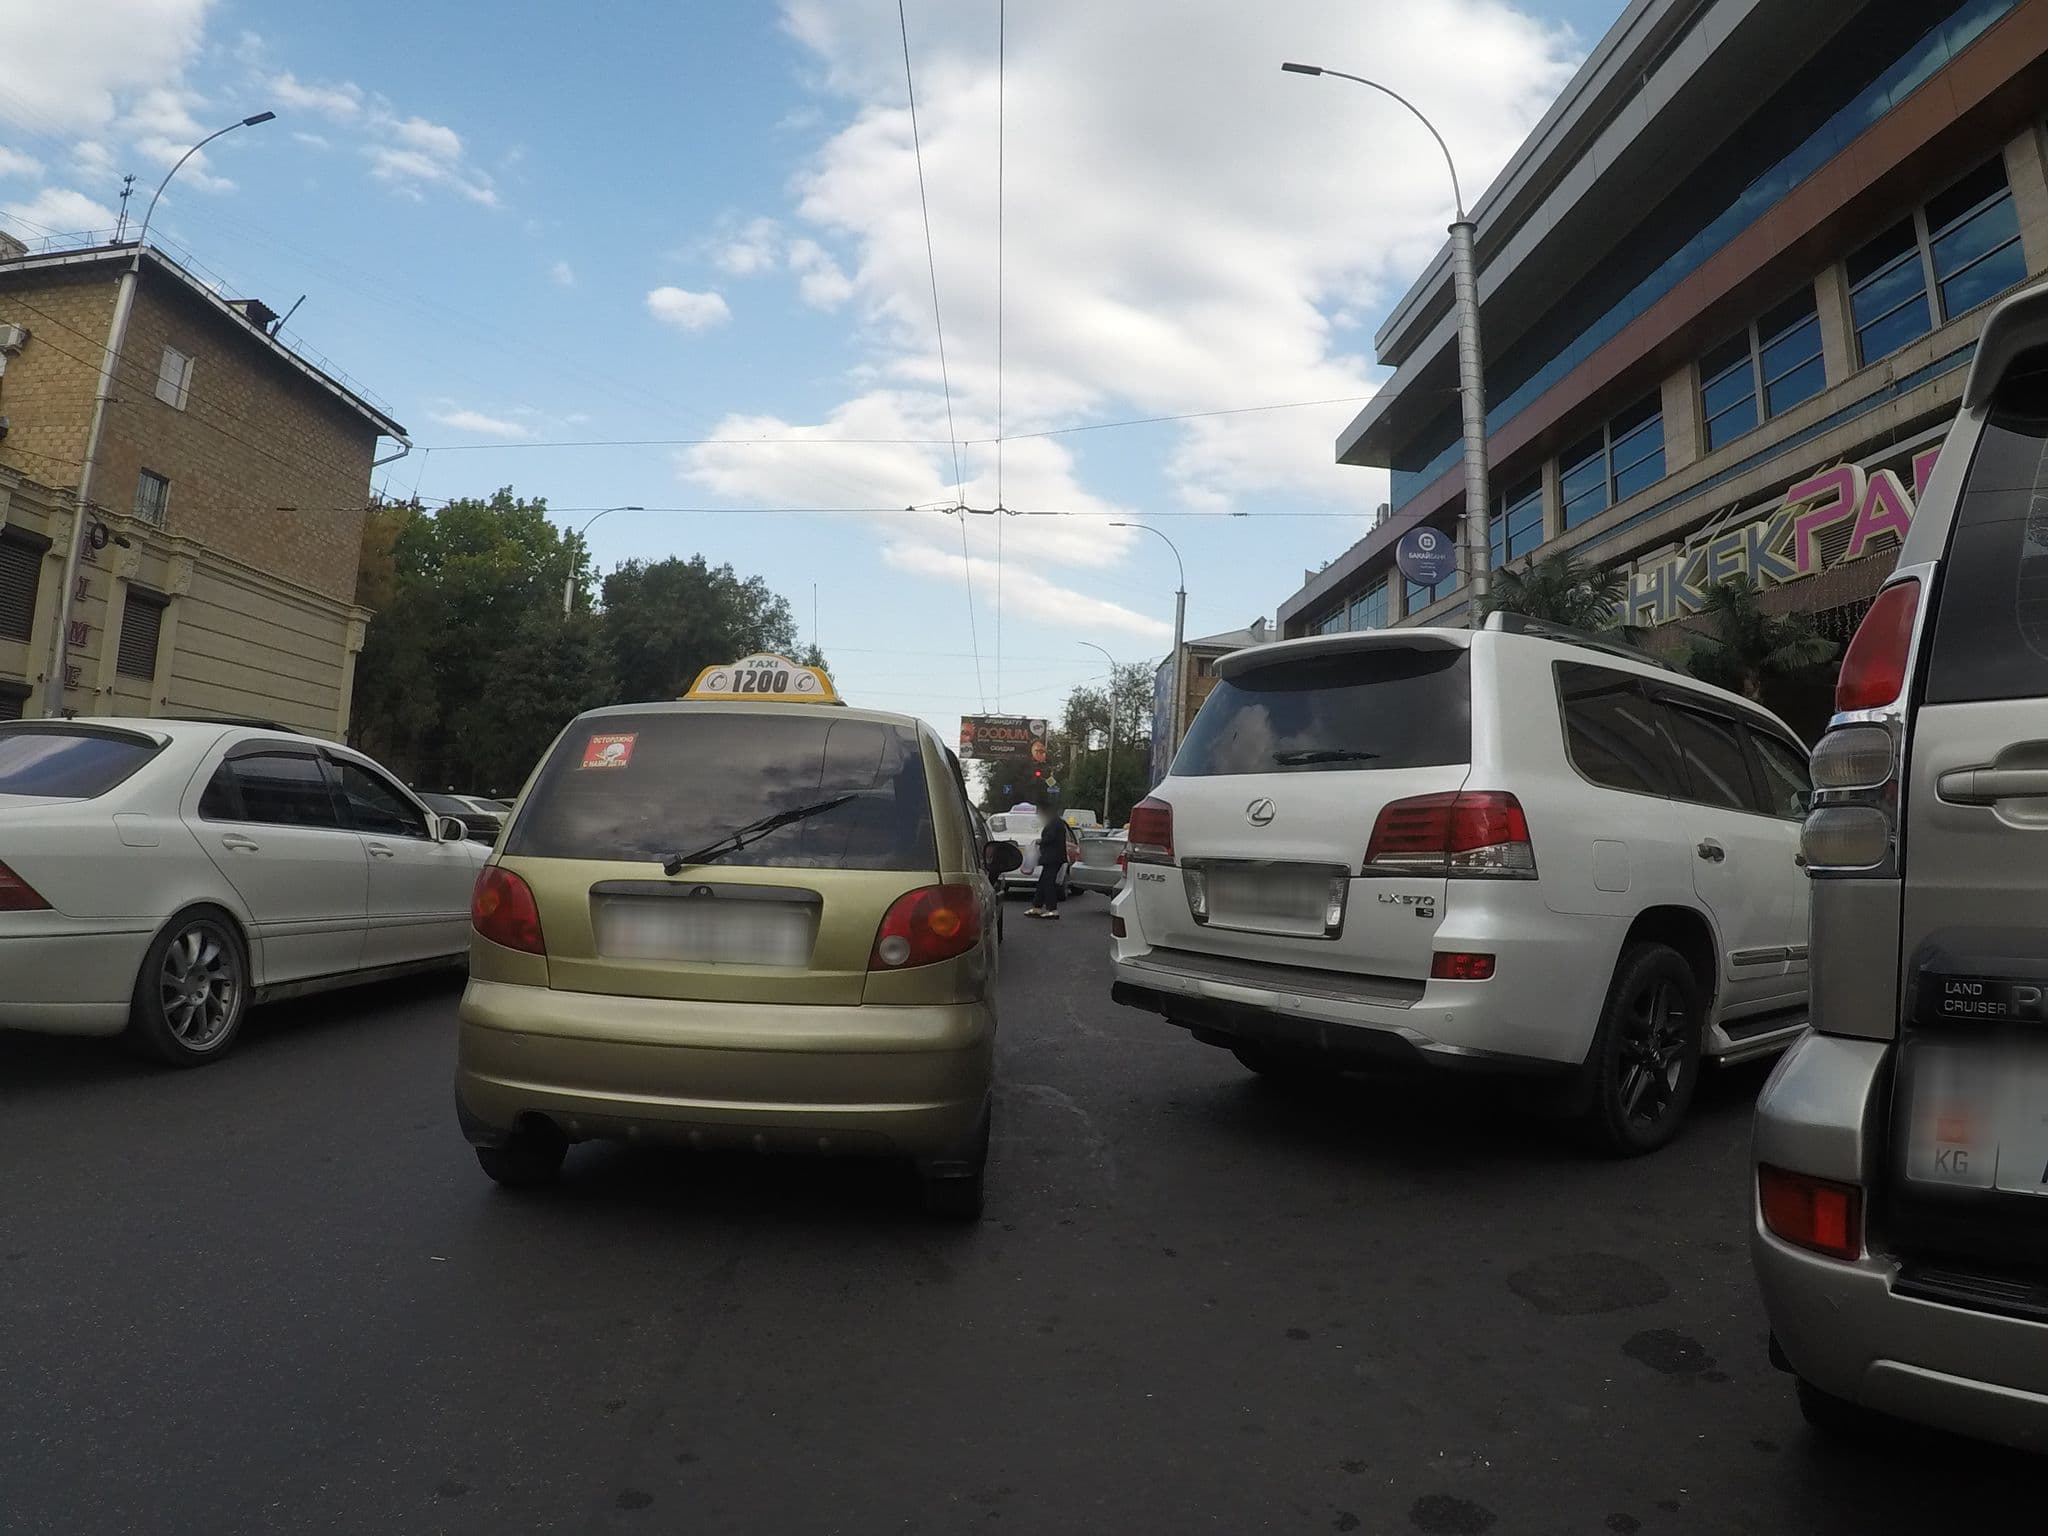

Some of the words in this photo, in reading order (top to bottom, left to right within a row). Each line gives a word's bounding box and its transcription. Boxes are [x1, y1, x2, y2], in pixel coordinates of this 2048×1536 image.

[747, 660, 779, 668] TAXI
[732, 670, 789, 693] 1200
[592, 735, 634, 744] ОСТОРОЖНО
[977, 727, 1029, 740] PODIUM
[1378, 894, 1400, 904] LX
[1402, 895, 1435, 906] 570
[1945, 982, 1983, 996] LAND
[1944, 999, 2007, 1015] CRUISER
[2012, 985, 2048, 1016] P
[1935, 1149, 1969, 1177] KG
